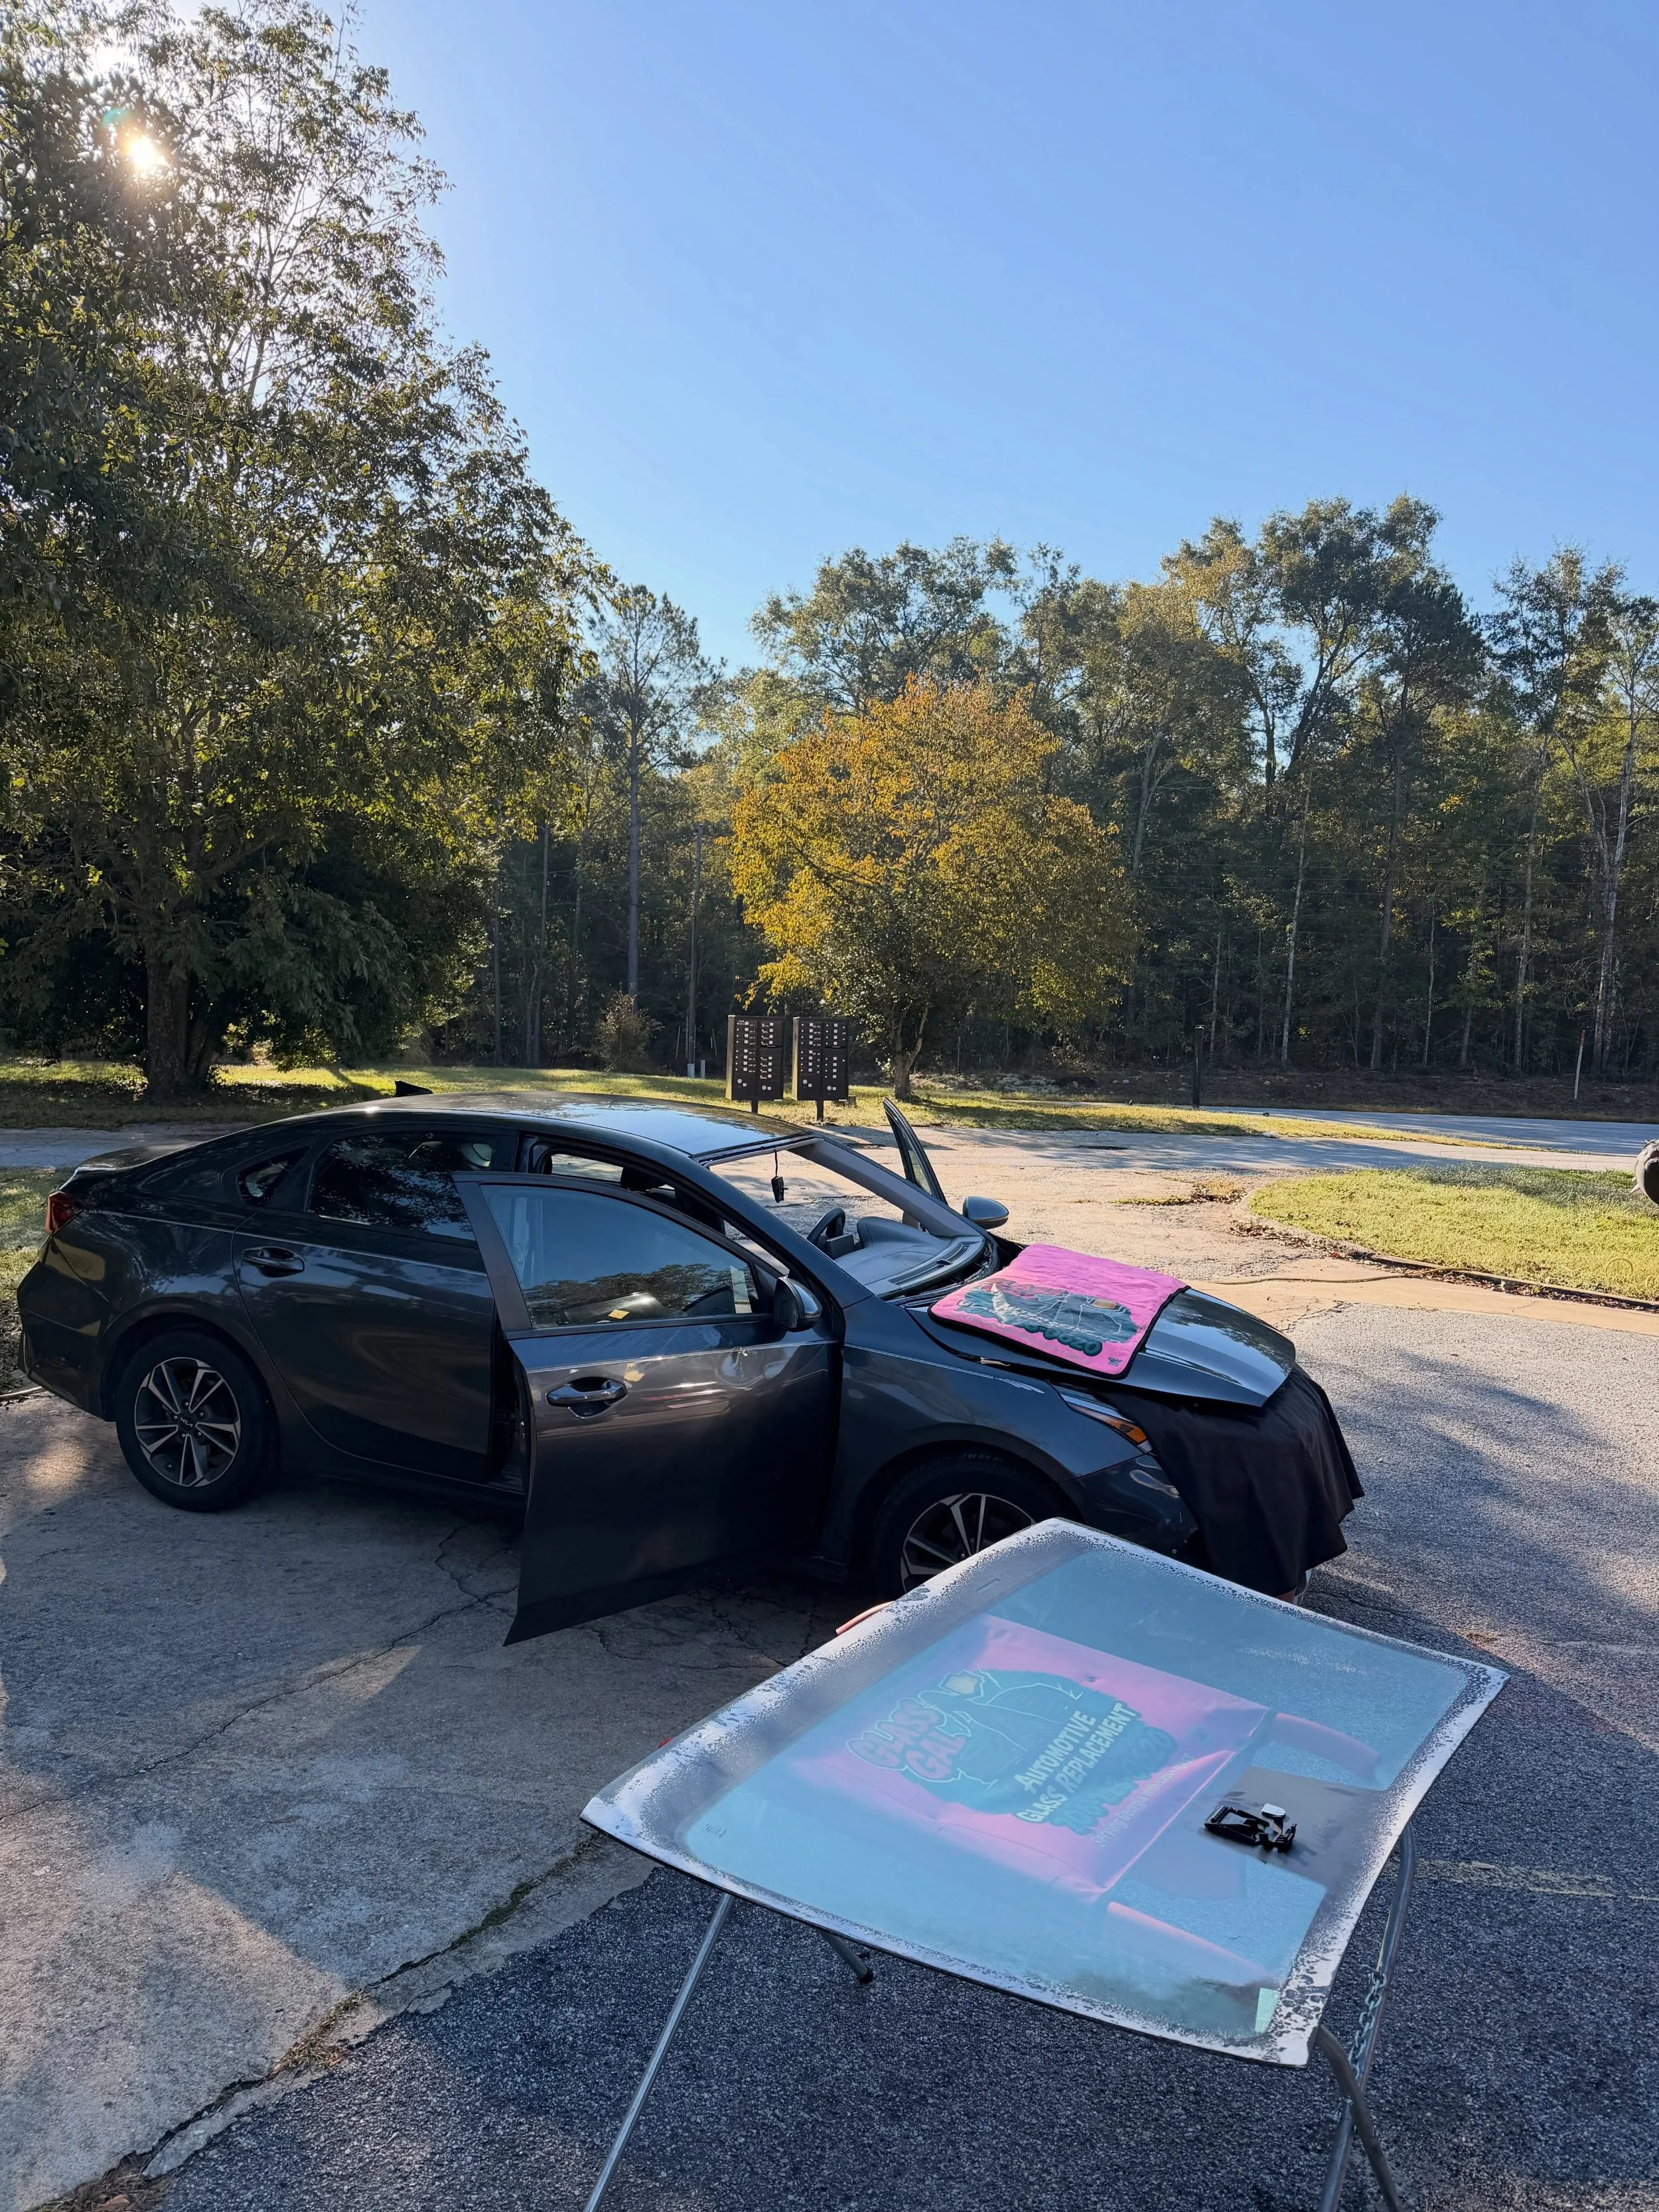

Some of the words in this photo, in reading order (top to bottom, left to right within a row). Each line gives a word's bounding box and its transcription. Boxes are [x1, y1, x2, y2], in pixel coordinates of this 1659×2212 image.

[851, 1702, 938, 1767] GLASS
[905, 1731, 966, 1779] GAL
[1013, 1710, 1097, 1795] AUTOMOTIVE
[1016, 1785, 1068, 1823] GLASS
[1054, 1702, 1138, 1794] REPLACEMENT
[1090, 1816, 1128, 1848] Serving
[1117, 1793, 1150, 1822] Georgia
